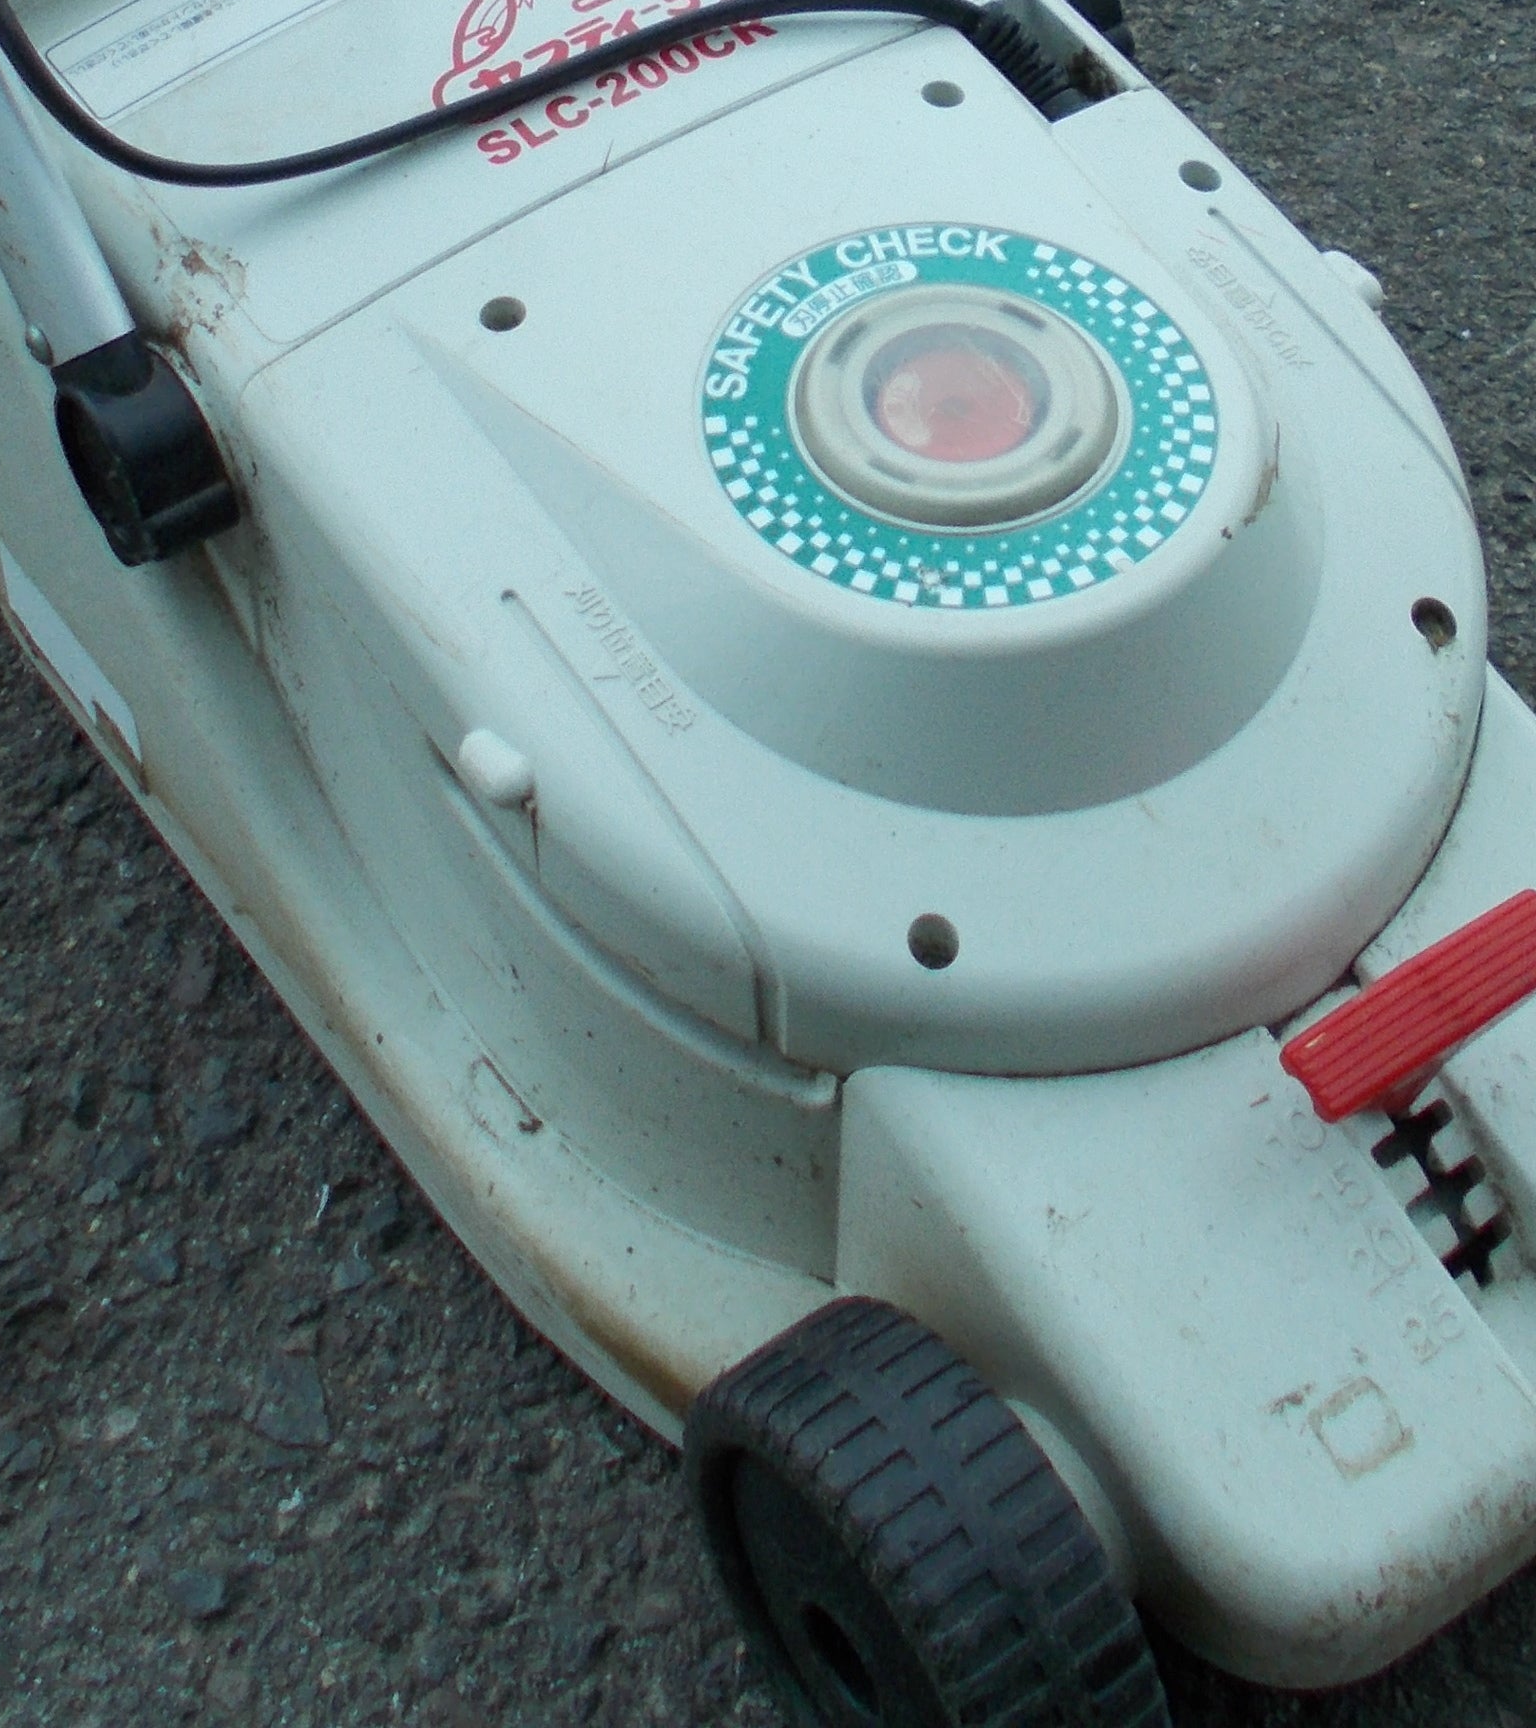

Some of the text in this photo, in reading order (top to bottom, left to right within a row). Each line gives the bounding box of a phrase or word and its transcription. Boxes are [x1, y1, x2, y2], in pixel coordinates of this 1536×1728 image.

[477, 19, 778, 164] SLC-200CR
[707, 225, 1011, 401] SAFETY CHECK
